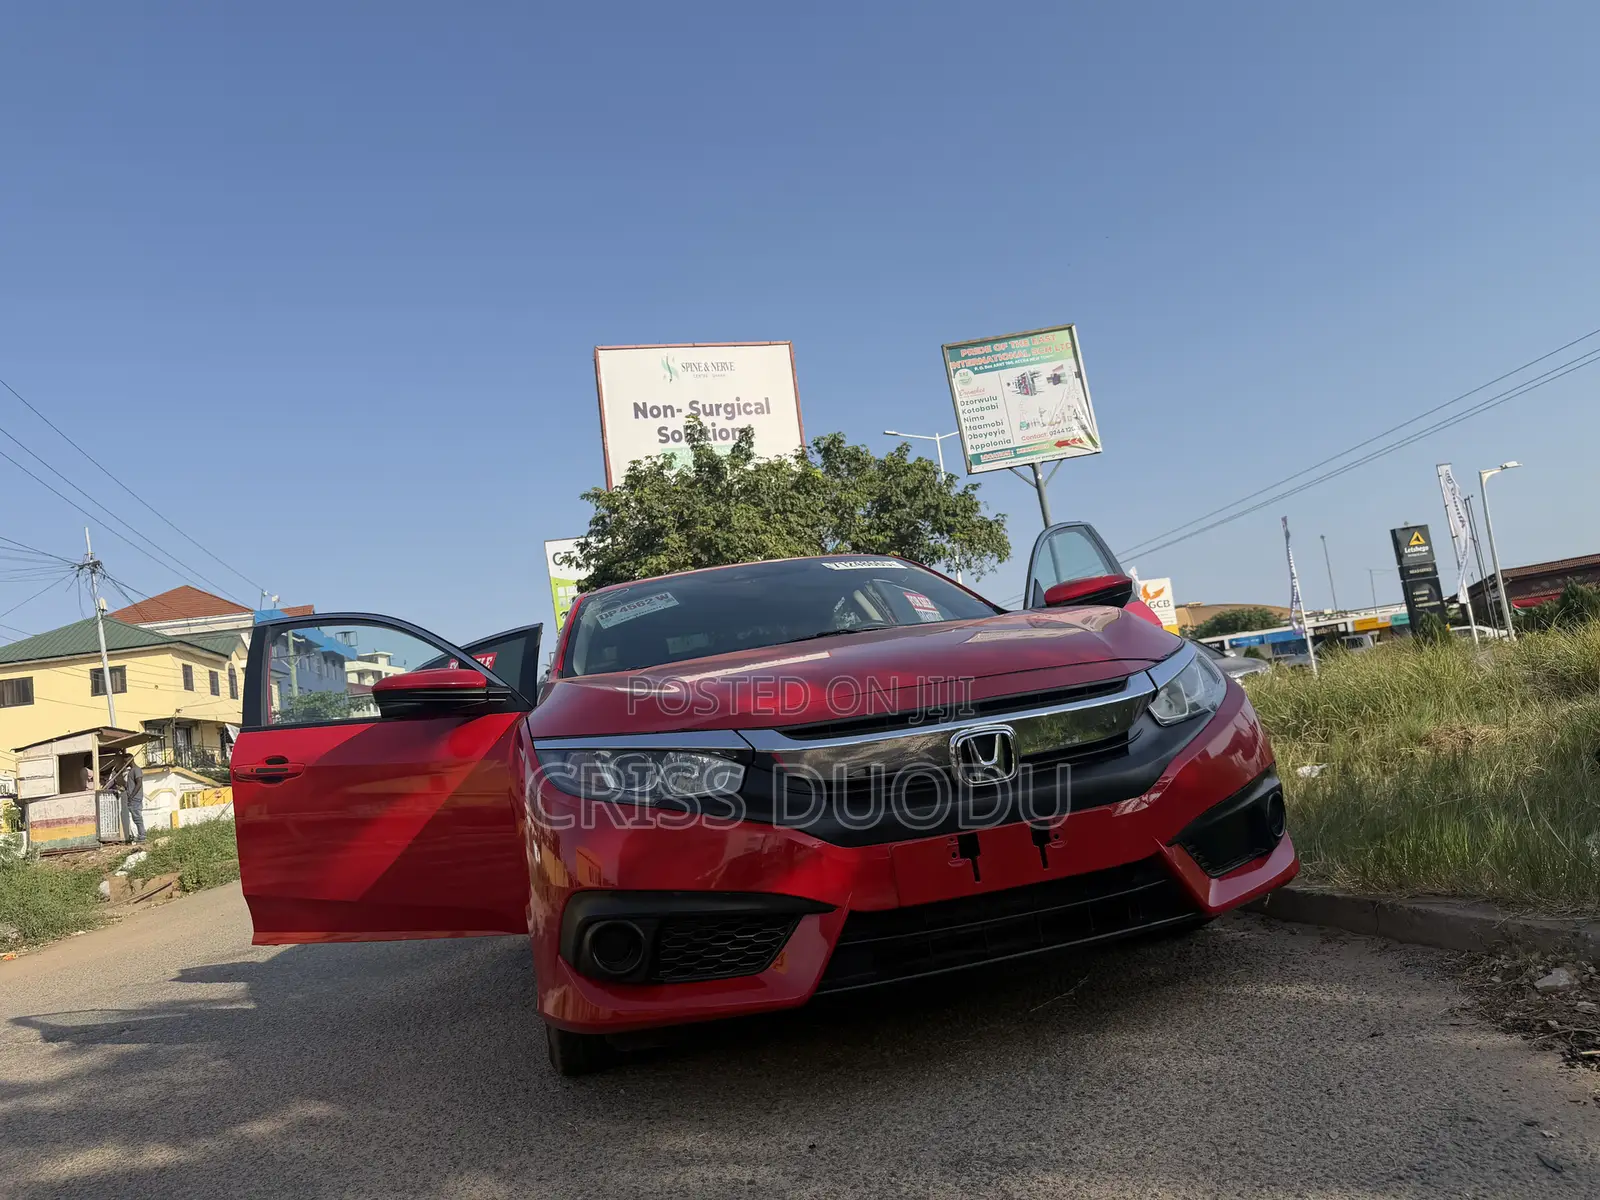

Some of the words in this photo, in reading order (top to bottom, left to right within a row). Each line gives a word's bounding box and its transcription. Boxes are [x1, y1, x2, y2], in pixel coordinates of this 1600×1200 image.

[960, 345, 992, 357] PRIDE
[993, 342, 1008, 352] OF
[1009, 339, 1030, 349] THE
[1031, 333, 1057, 345] EAST
[1031, 345, 1053, 356] SCH
[681, 361, 703, 373] SPINE
[703, 361, 710, 372] &
[711, 361, 736, 372] NERVE
[960, 395, 998, 407] Dzorwulu
[633, 401, 683, 419] Non-
[688, 396, 771, 420] Surgical
[961, 402, 999, 414] Kotobabi
[963, 414, 985, 423] Nima
[970, 438, 1012, 451] Appolonia
[1148, 599, 1171, 609] GCB
